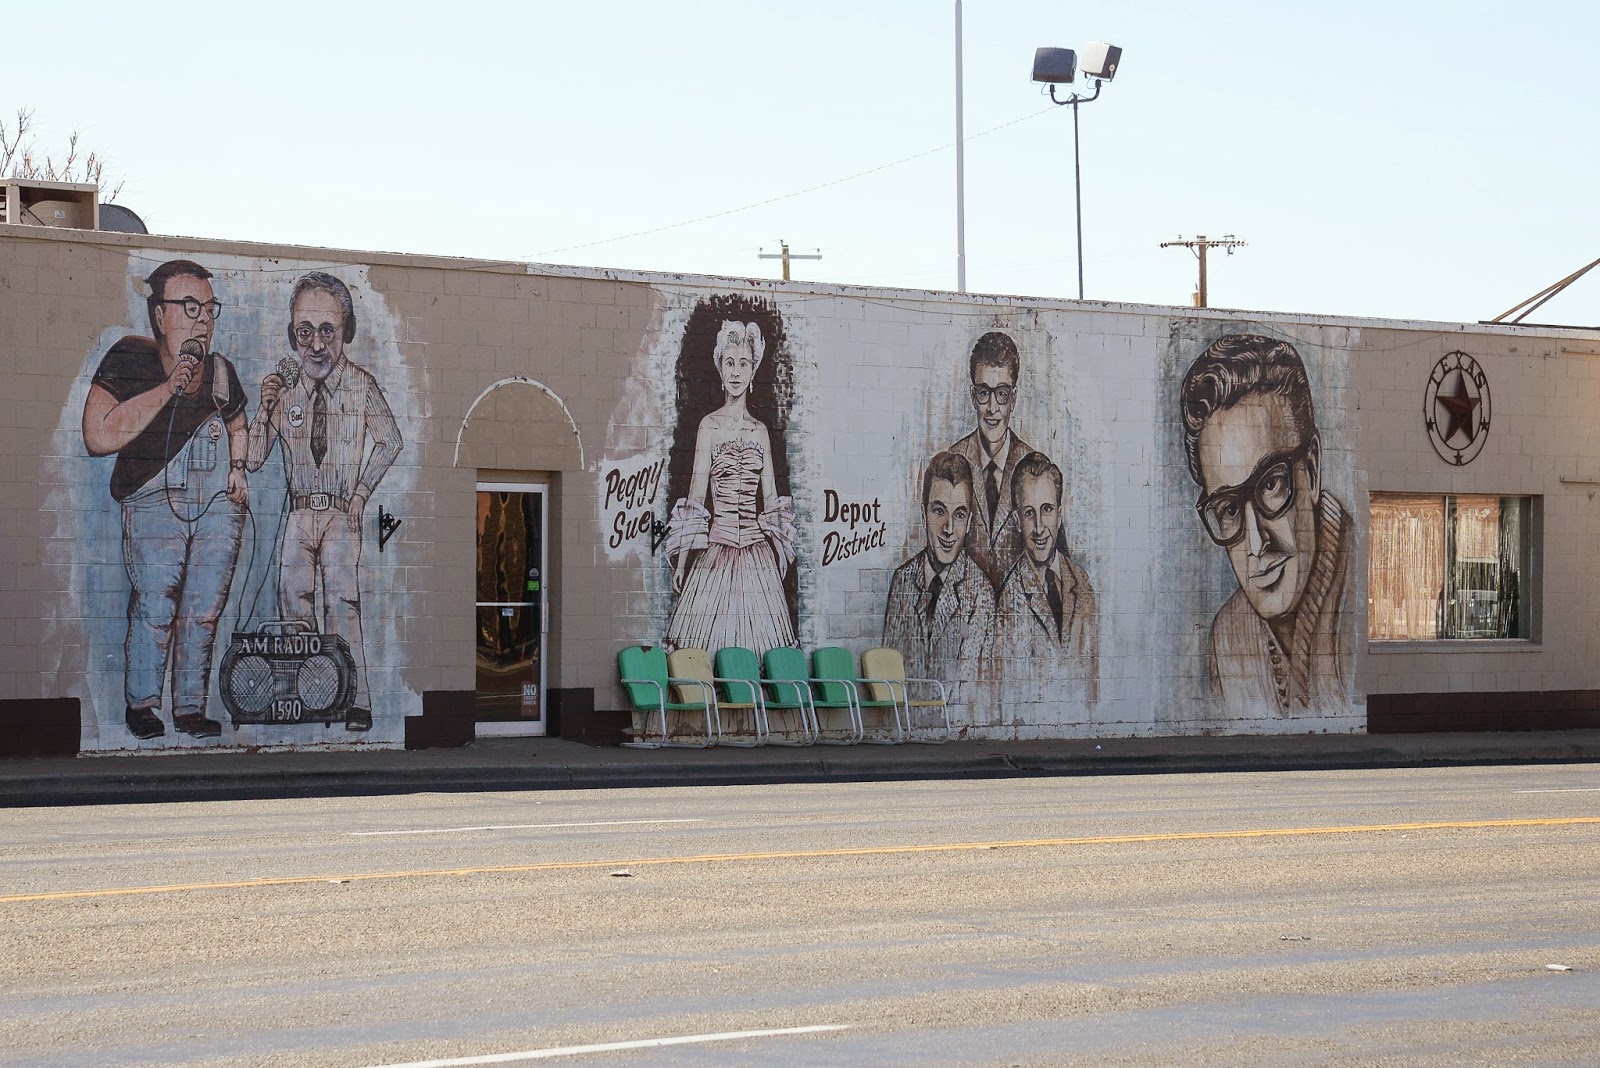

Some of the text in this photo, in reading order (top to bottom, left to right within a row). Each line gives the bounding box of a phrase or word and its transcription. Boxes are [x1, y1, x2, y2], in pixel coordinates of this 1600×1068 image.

[1429, 351, 1486, 389] TEXAS
[605, 458, 665, 510] Peggy
[823, 489, 881, 531] Depot
[609, 510, 651, 549] Sue
[821, 521, 887, 567] District
[239, 635, 321, 655] AM RADIO
[523, 684, 537, 696] NO
[271, 699, 302, 721] 1590
